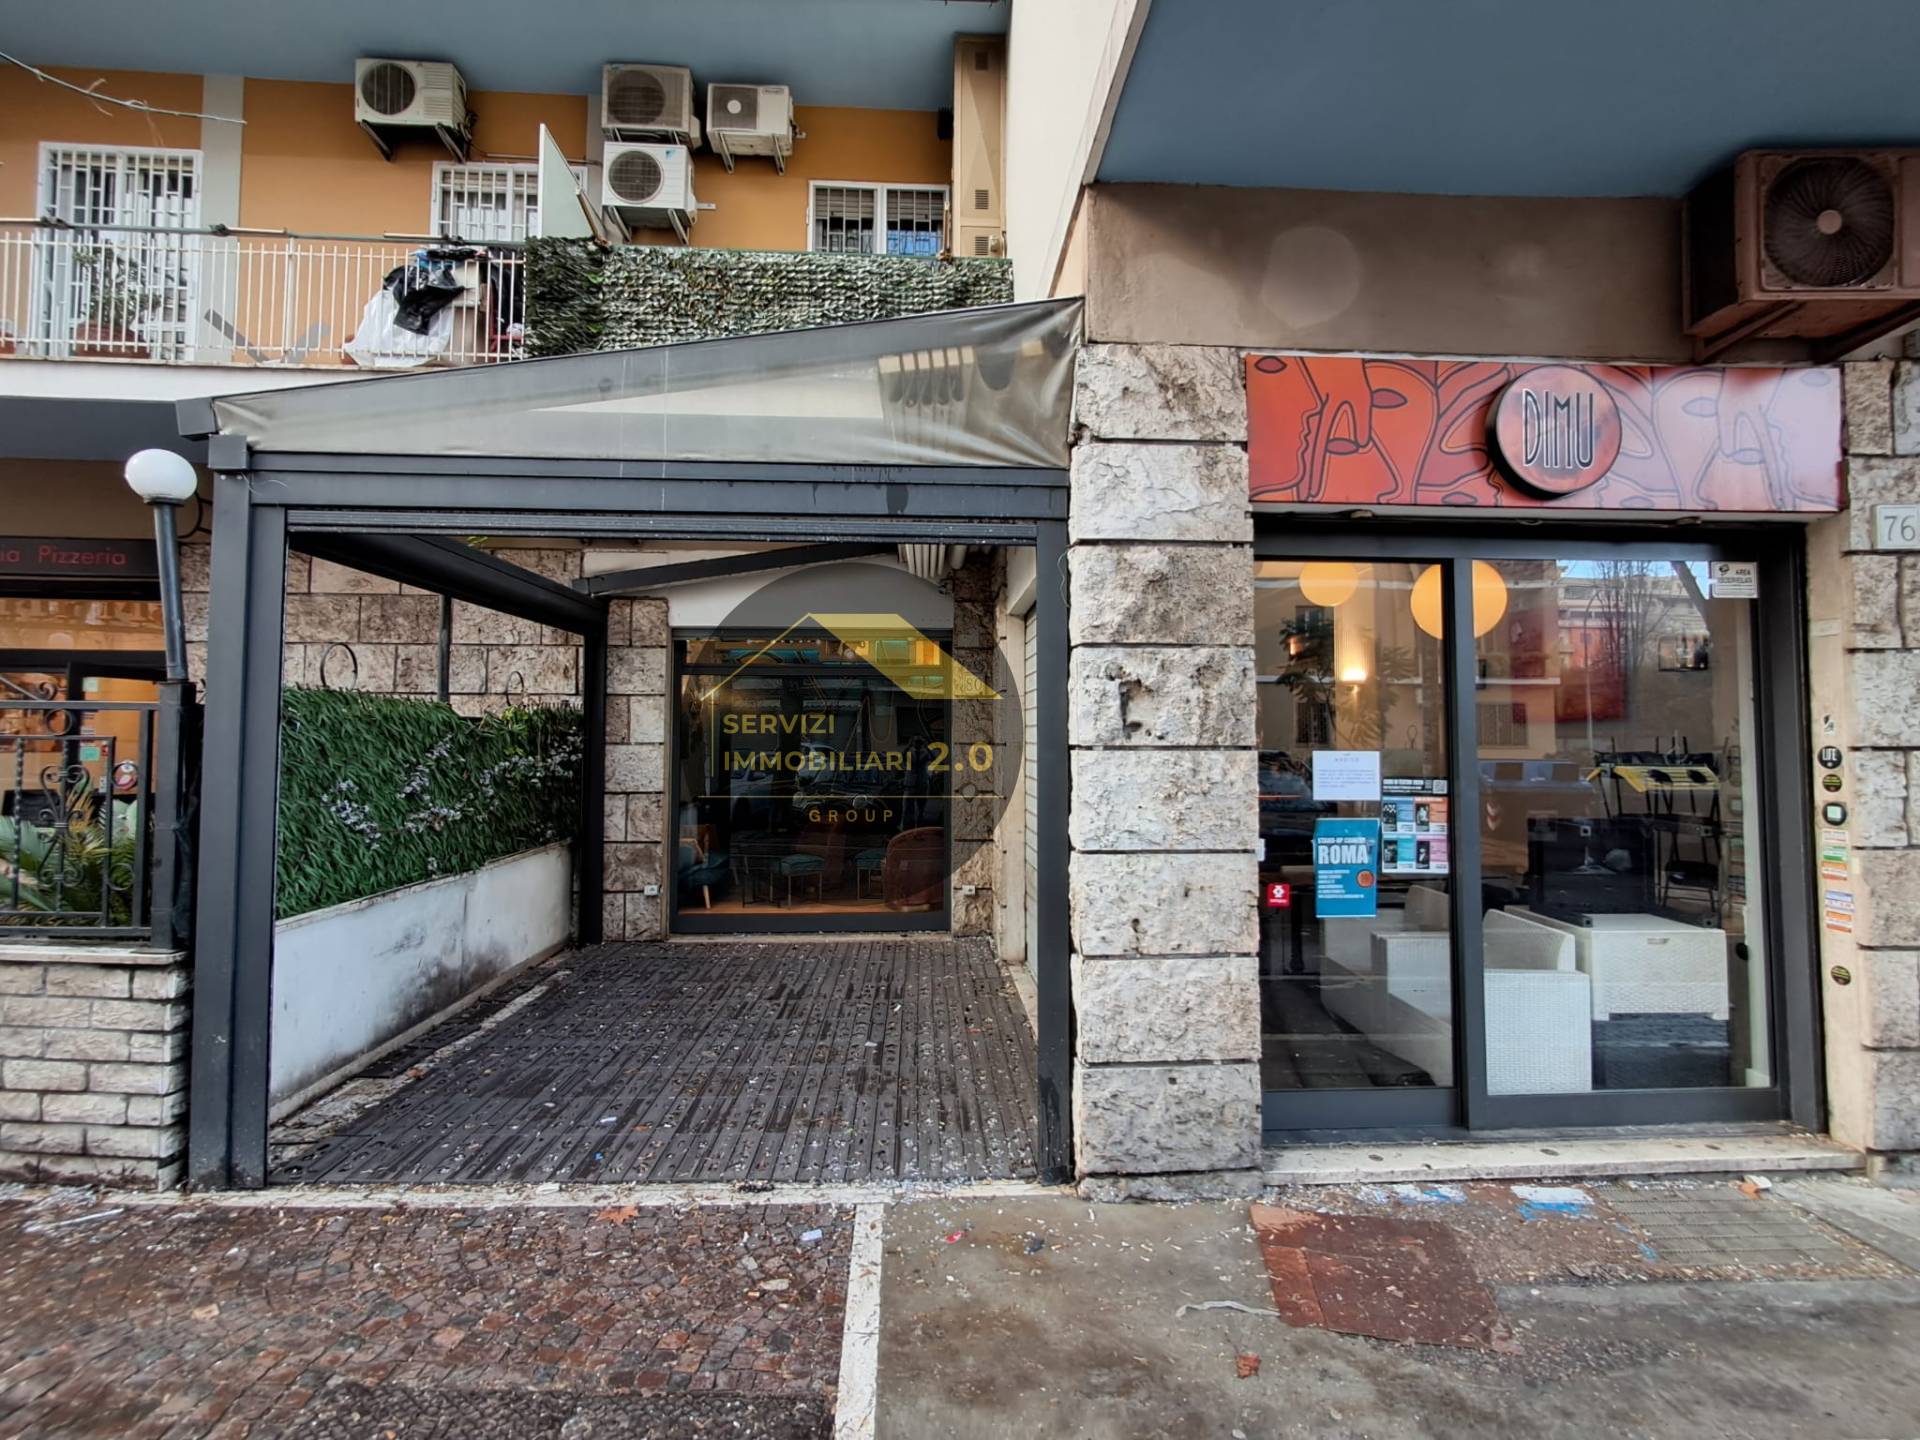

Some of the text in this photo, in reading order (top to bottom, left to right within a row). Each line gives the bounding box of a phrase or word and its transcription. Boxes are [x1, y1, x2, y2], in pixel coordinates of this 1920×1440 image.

[1523, 389, 1594, 469] DIMU
[1884, 515, 1916, 542] 76
[38, 545, 127, 565] Pizzeria
[1318, 845, 1369, 865] ROMA
